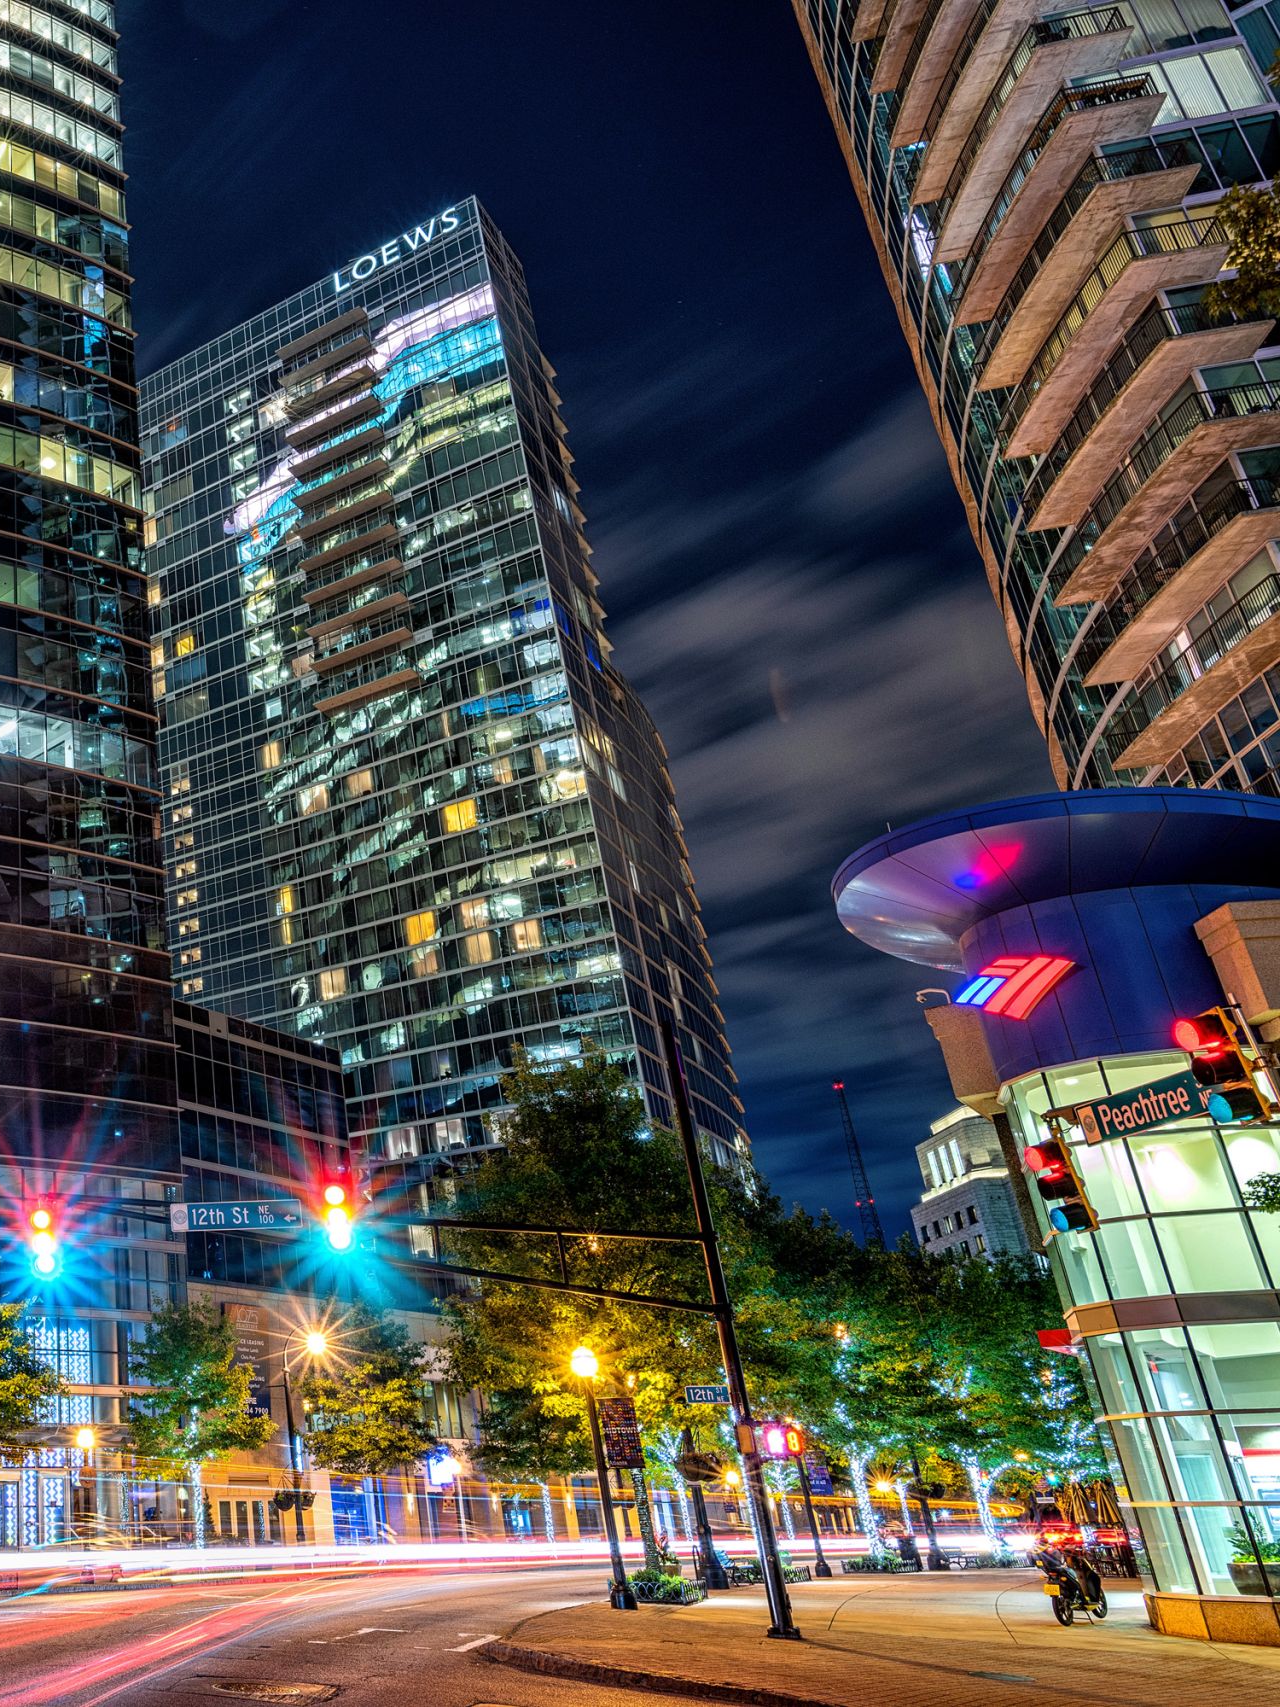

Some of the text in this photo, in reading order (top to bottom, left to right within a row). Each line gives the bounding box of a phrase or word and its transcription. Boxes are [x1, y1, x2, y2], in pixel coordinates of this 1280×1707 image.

[333, 207, 458, 293] LOEWS
[1097, 1086, 1190, 1135] Peachtree
[192, 1205, 270, 1225] 12th St NE
[259, 1215, 275, 1224] 100
[690, 1389, 714, 1401] 12th
